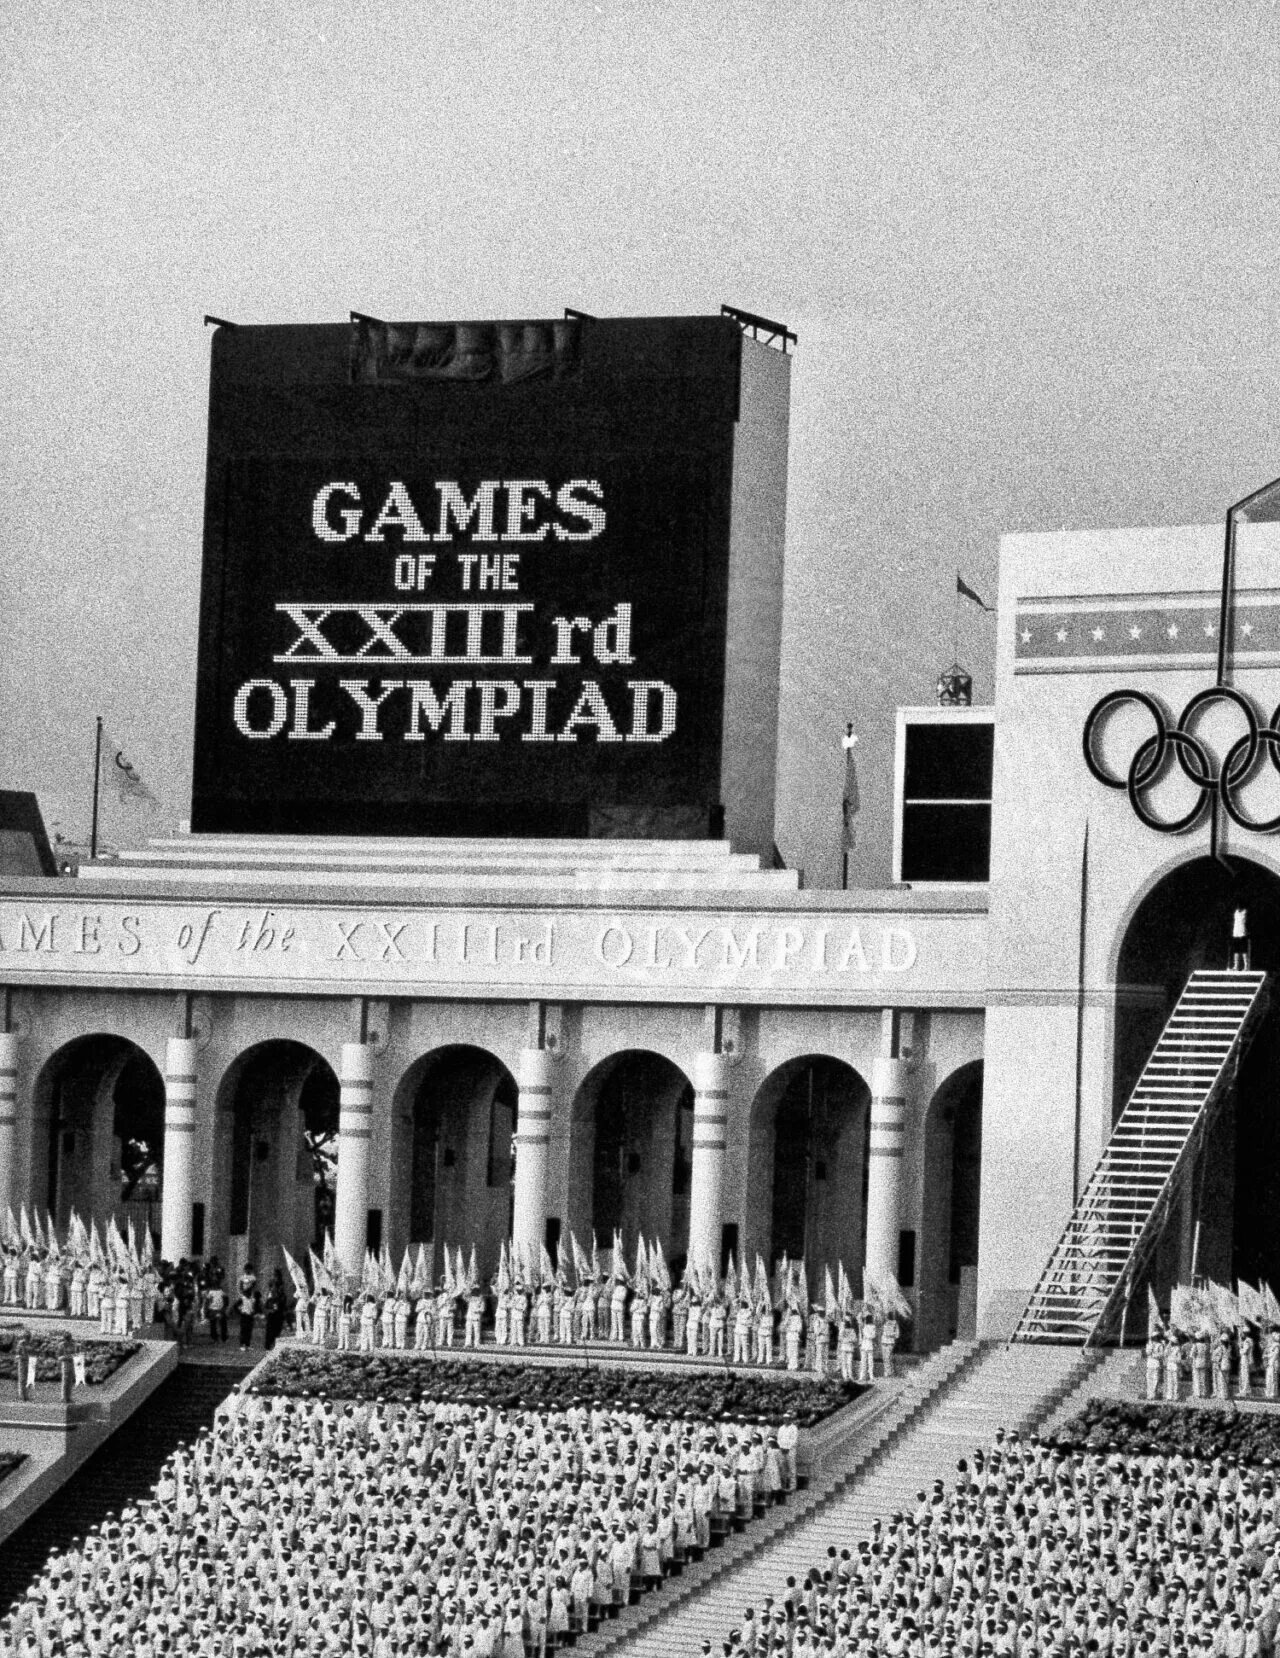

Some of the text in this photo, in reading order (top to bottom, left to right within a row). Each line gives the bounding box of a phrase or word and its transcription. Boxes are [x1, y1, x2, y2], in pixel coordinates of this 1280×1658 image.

[312, 479, 607, 542] GAMES
[394, 554, 520, 590] OF THE
[233, 679, 678, 743] OLYMPIAD
[0, 913, 141, 956] MES
[177, 909, 221, 965] of
[235, 910, 296, 953] the
[598, 924, 919, 972] OLYMPIAD
